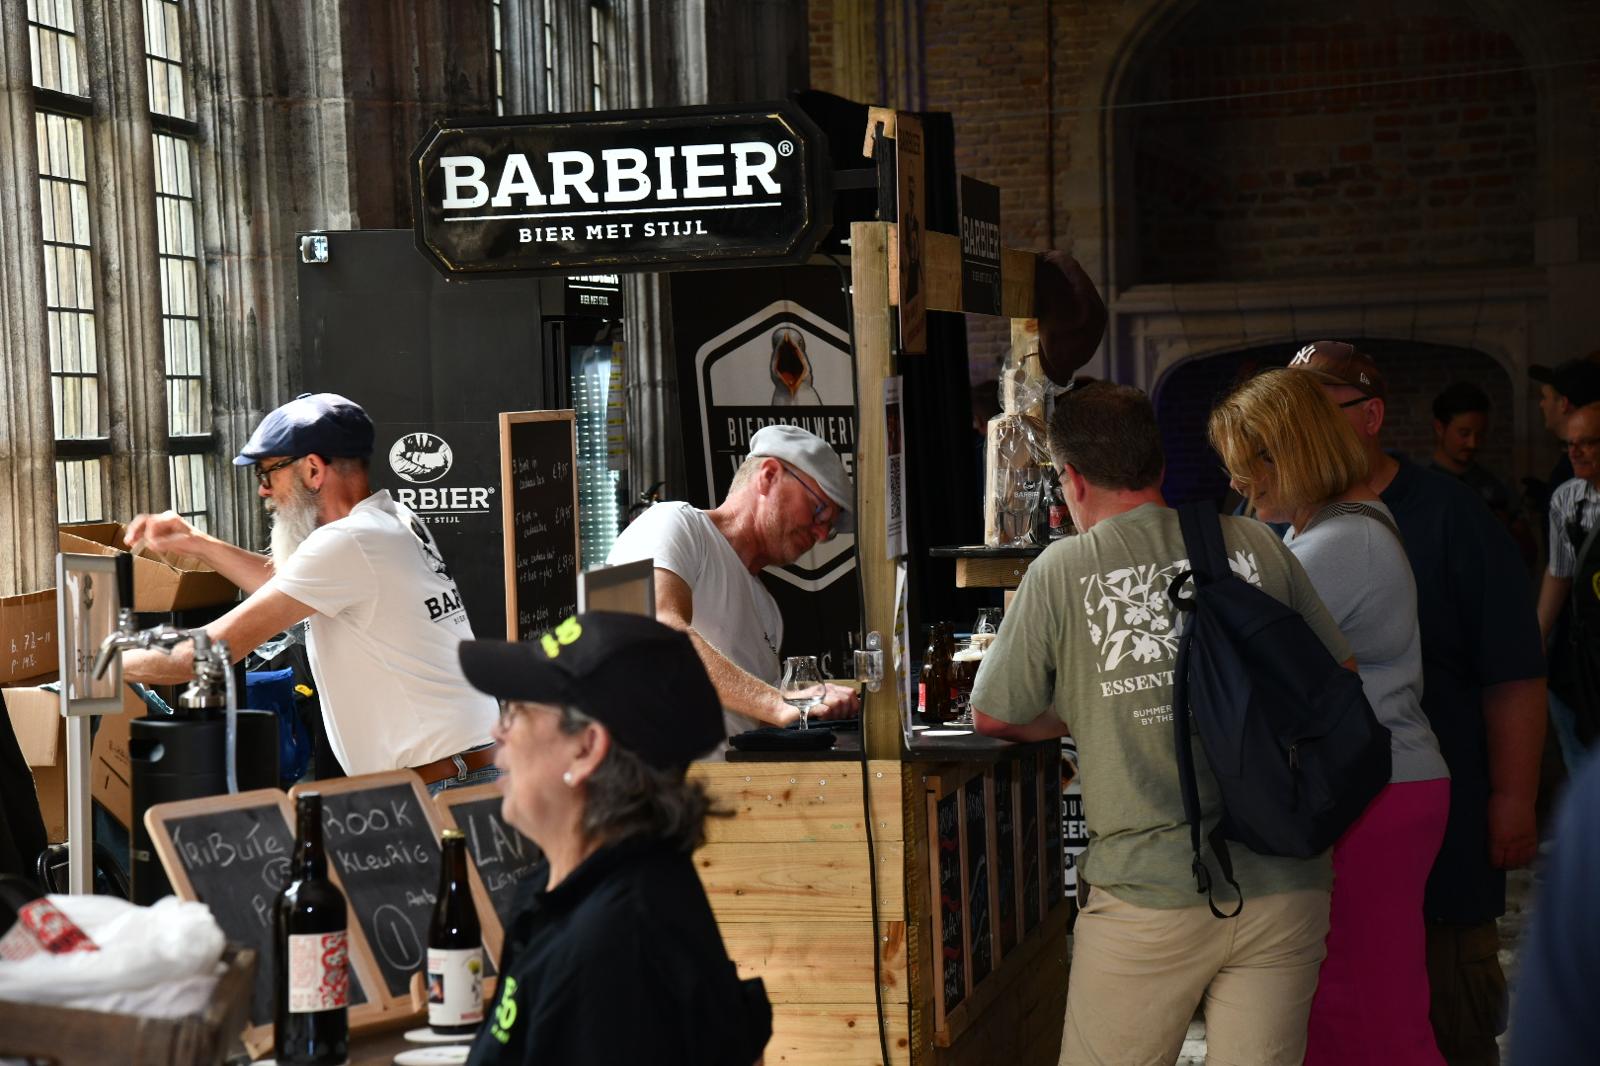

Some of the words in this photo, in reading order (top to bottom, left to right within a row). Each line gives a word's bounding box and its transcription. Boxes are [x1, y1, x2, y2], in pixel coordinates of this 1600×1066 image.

[518, 226, 575, 243] BIER
[586, 222, 634, 240] MET
[644, 219, 708, 238] STIJL
[963, 215, 1000, 262] BARBIER
[435, 516, 460, 524] STIJL
[1100, 670, 1175, 697] ESSENT
[1133, 704, 1173, 718] SUMMER
[1141, 717, 1153, 726] BY
[1155, 713, 1174, 724] THE
